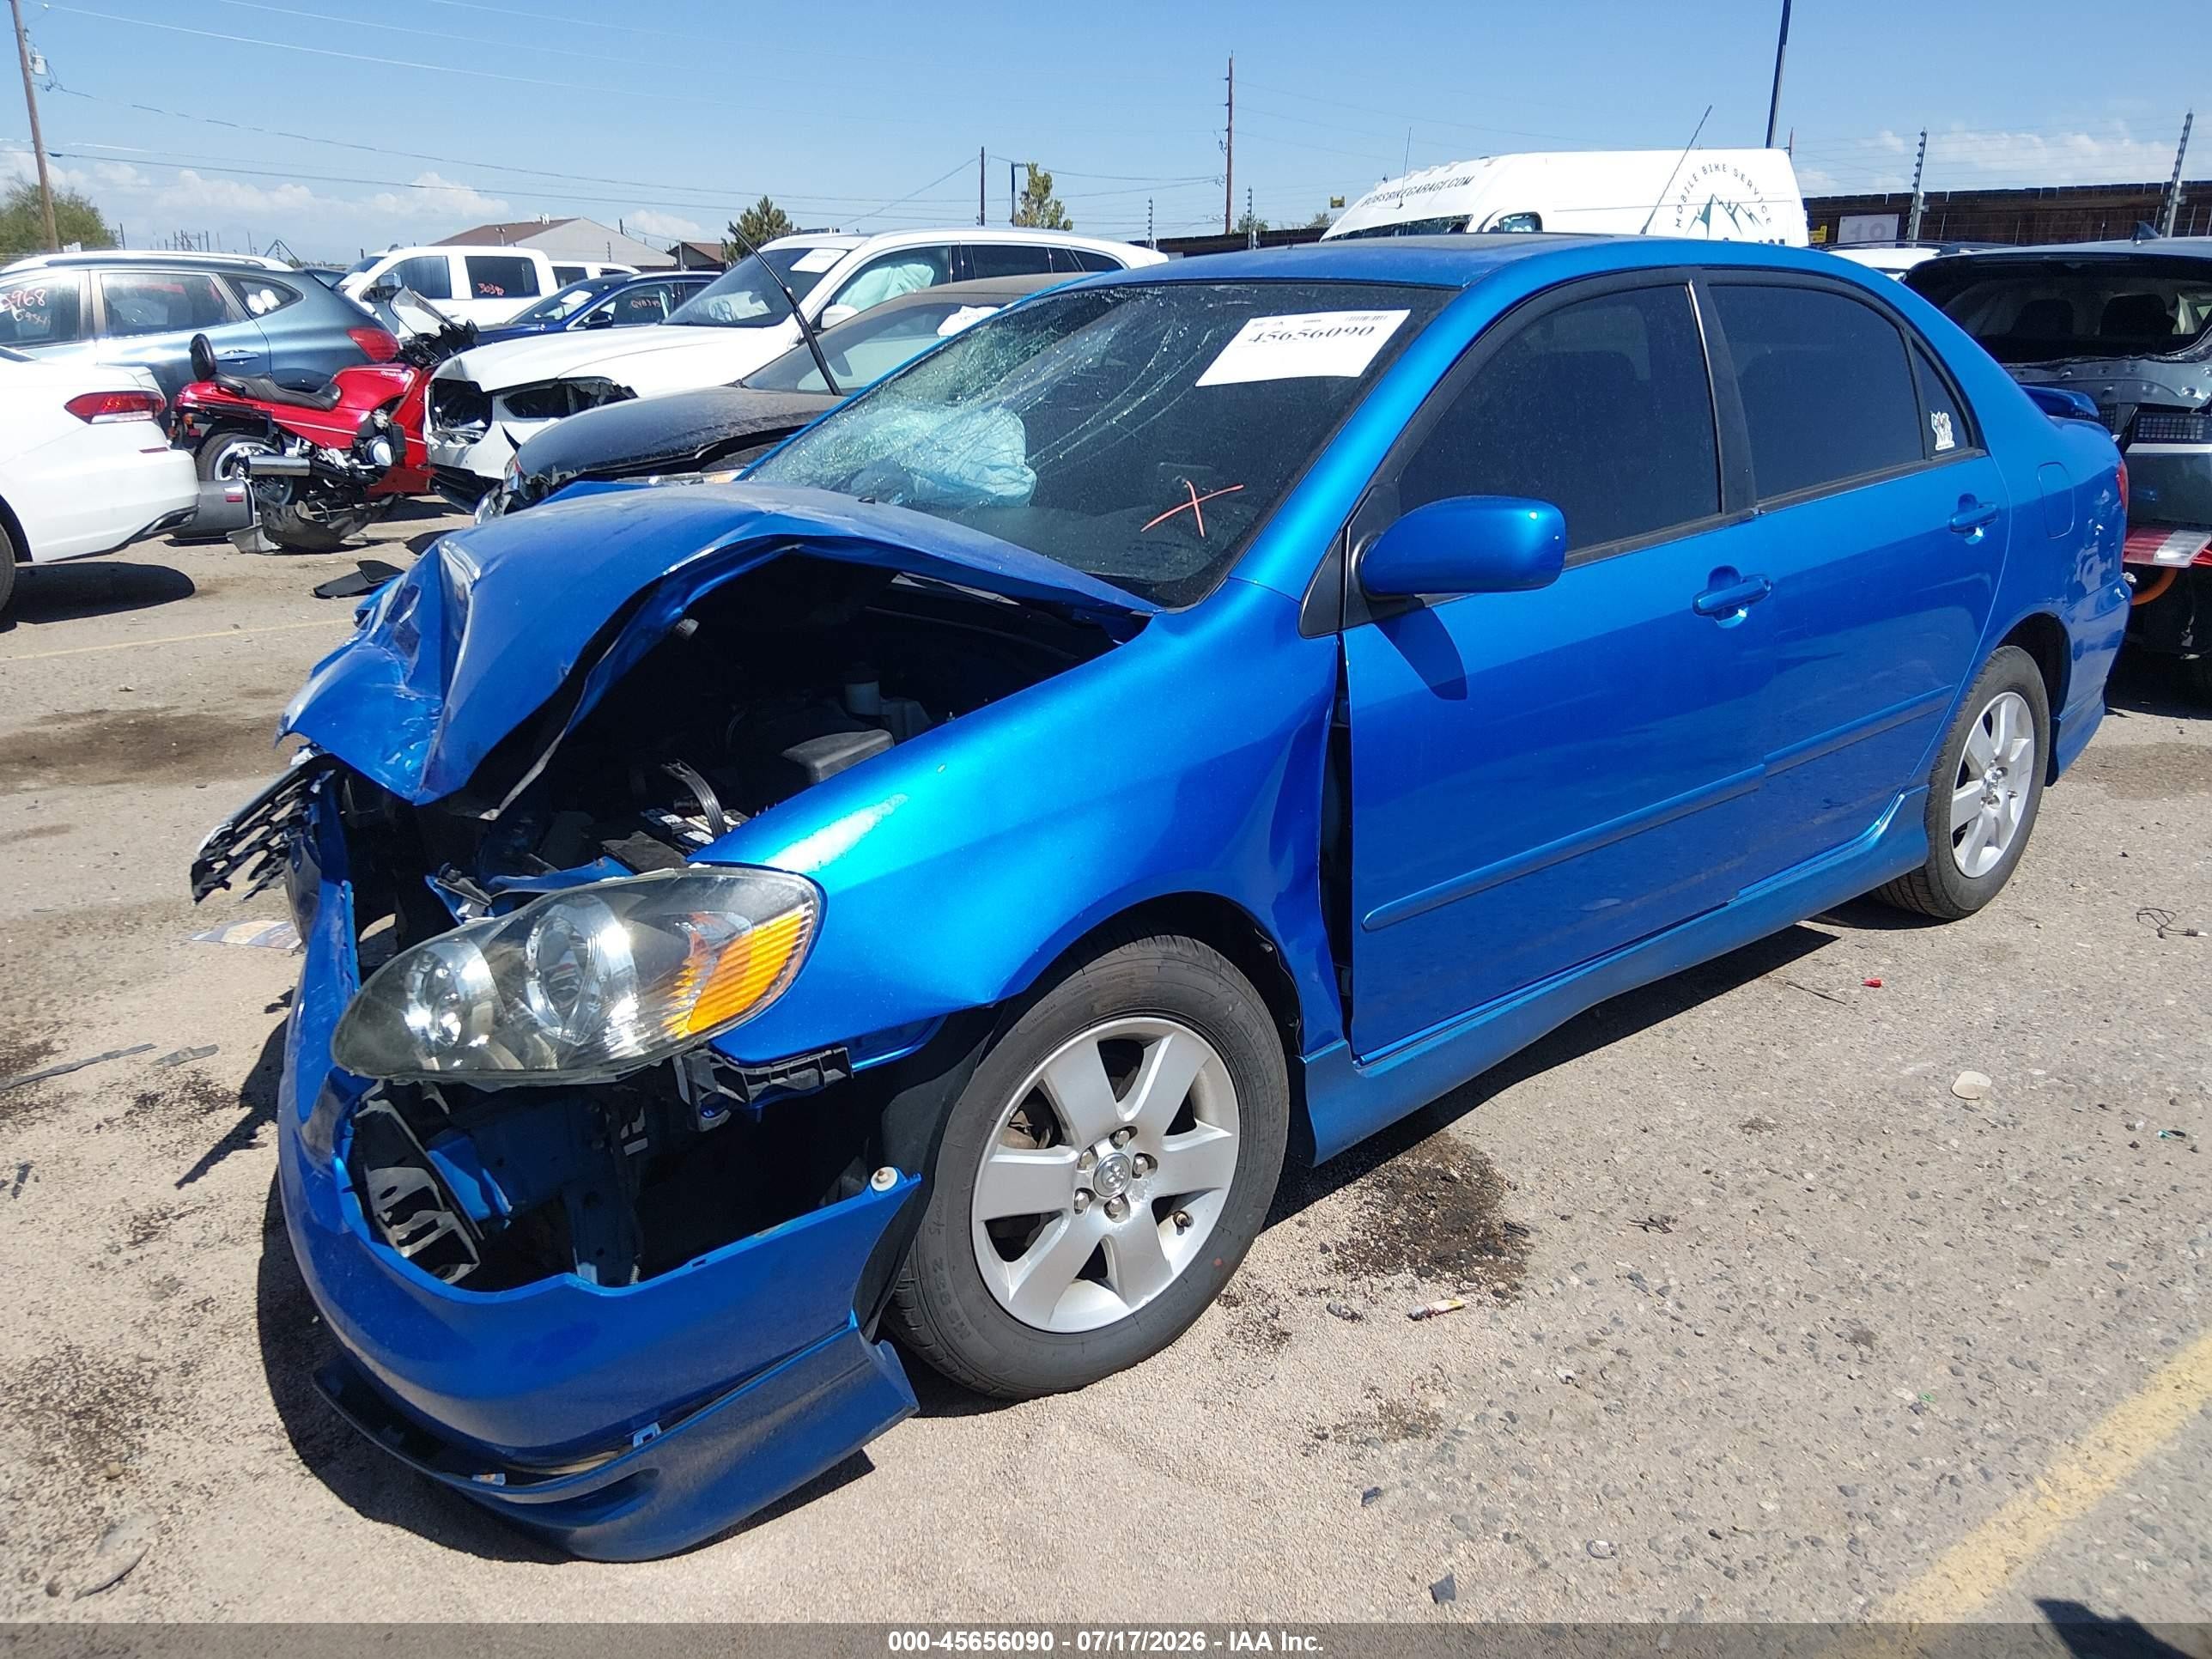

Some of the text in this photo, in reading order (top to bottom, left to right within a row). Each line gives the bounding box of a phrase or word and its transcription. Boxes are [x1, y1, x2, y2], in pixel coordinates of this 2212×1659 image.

[1675, 163, 1772, 228] MOBILE BIKE SERVICE
[1248, 325, 1376, 343] 45656090
